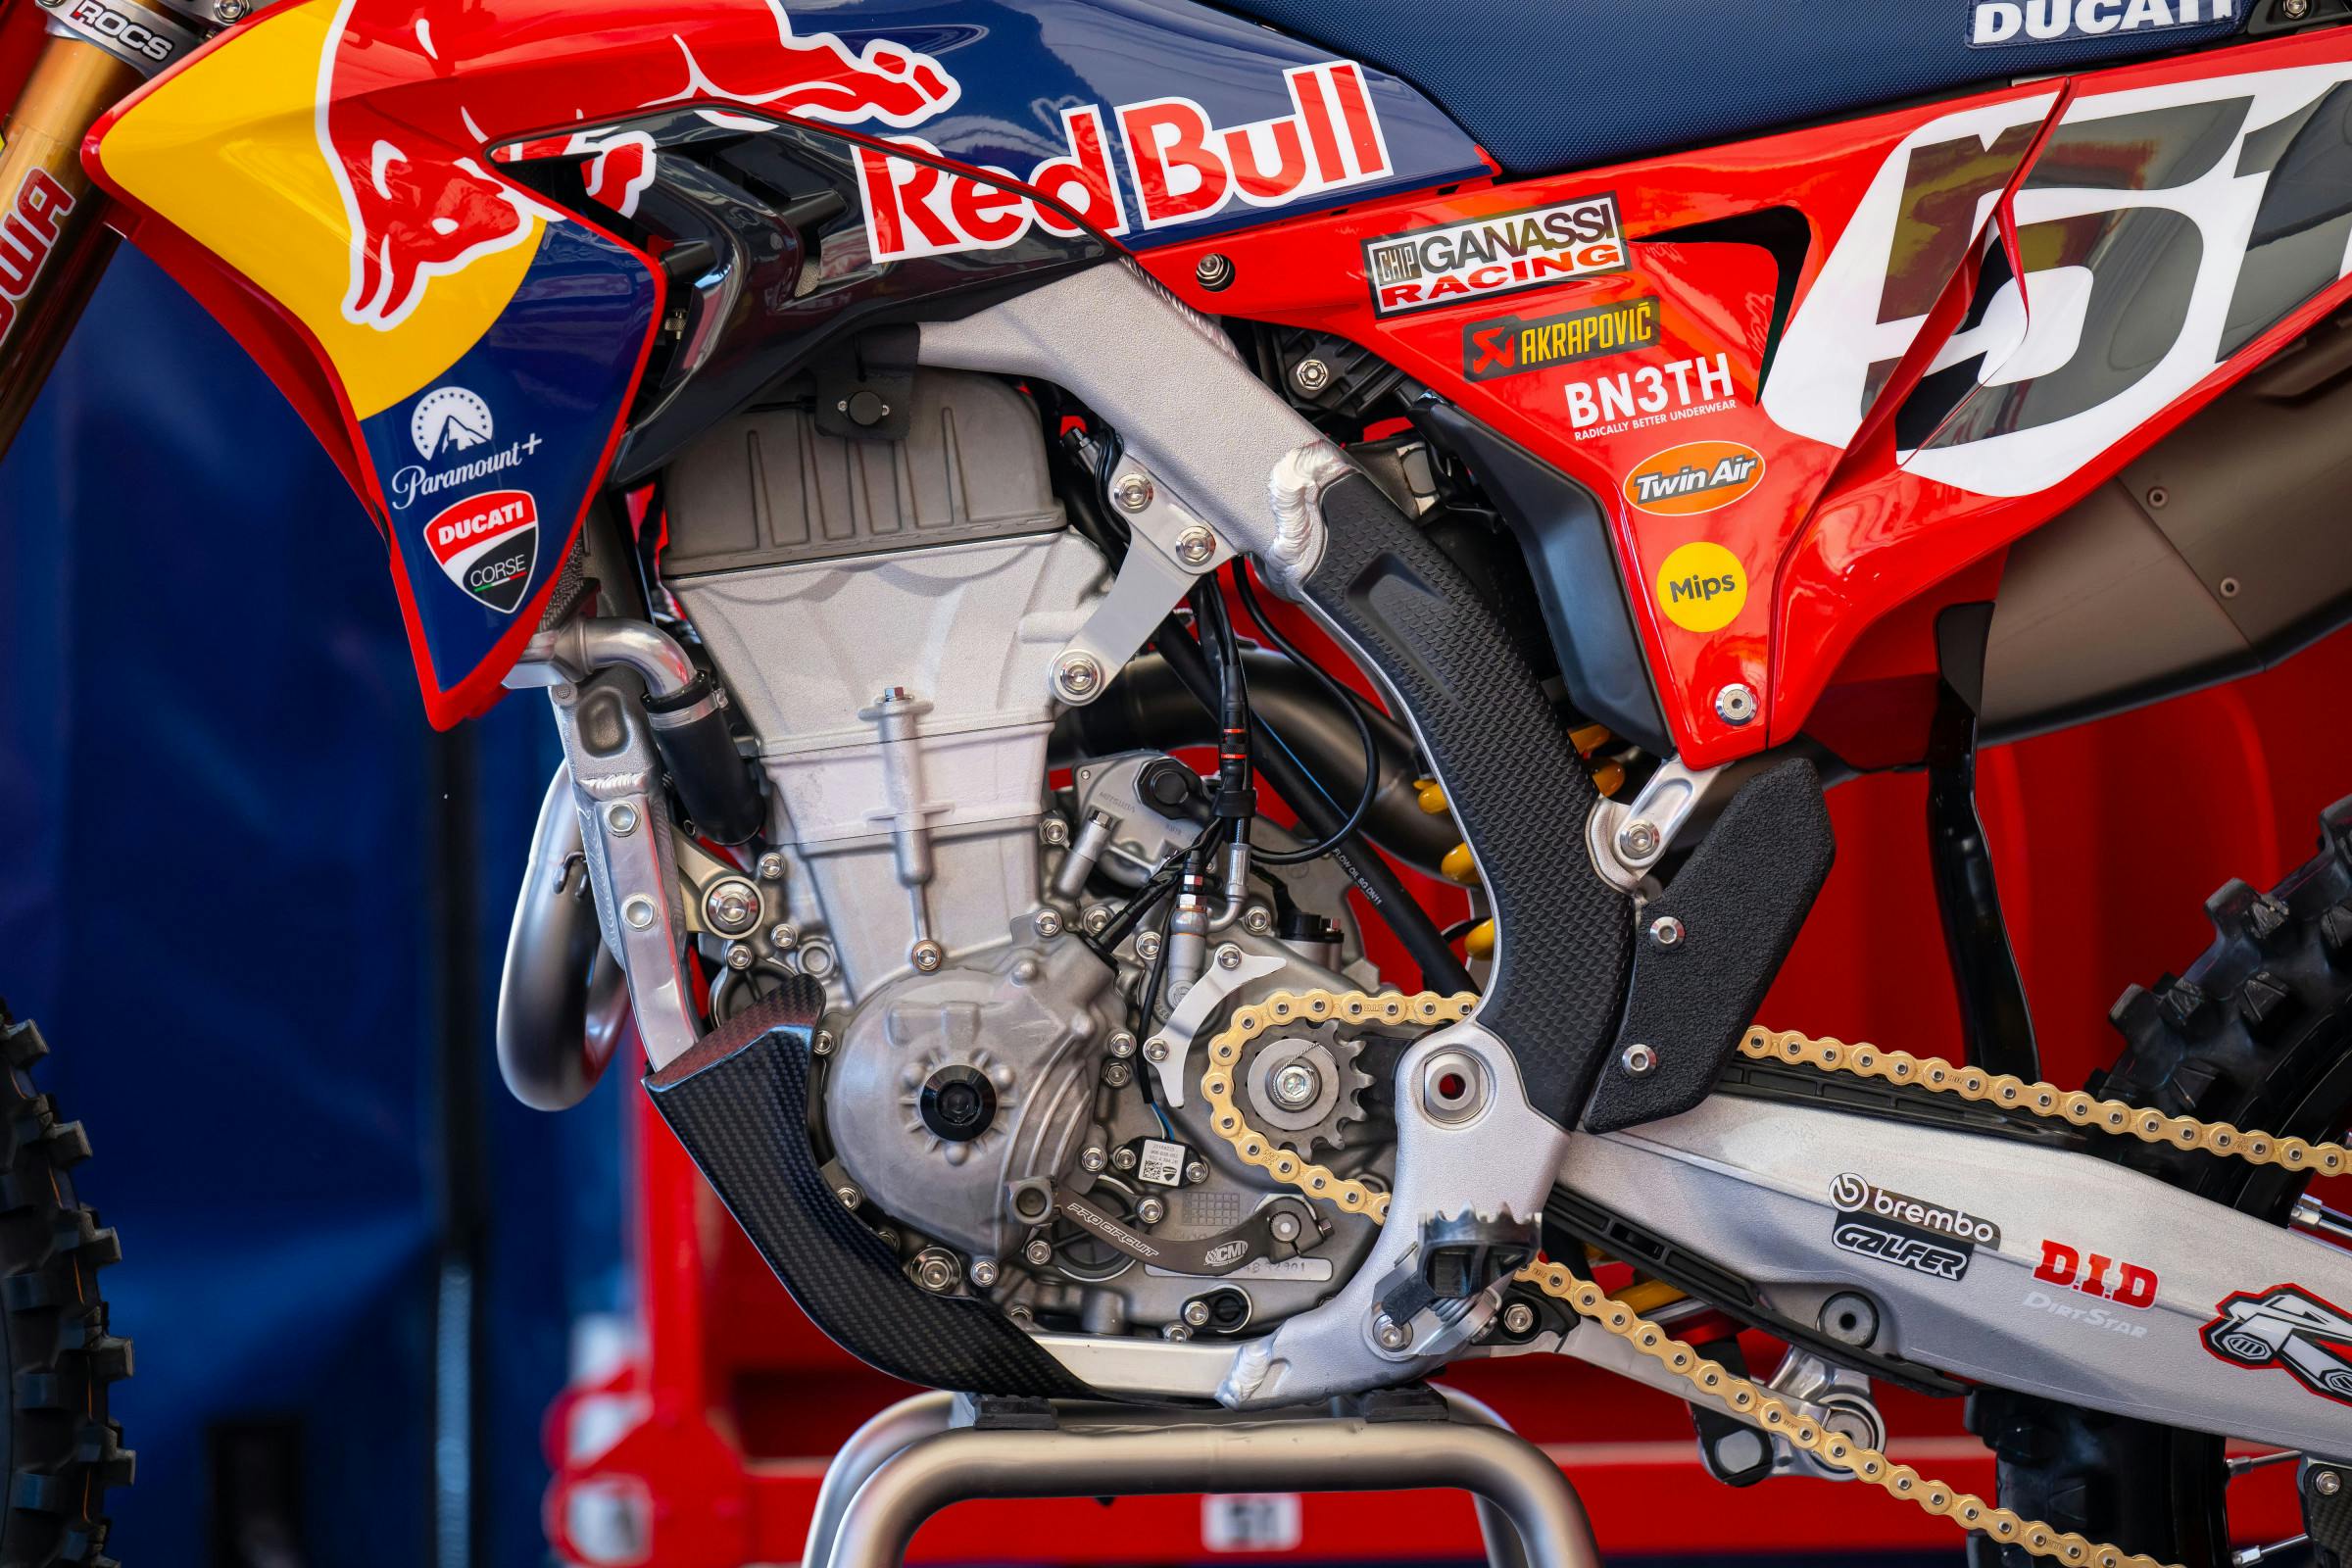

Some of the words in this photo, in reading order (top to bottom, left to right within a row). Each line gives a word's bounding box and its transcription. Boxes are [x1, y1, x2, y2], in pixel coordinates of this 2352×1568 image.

[74, 0, 172, 61] ROCS
[852, 107, 1128, 262] Red
[1116, 61, 1392, 228] Bull
[1377, 243, 1417, 283] CHIP
[1420, 204, 1615, 274] GANASSI
[1380, 244, 1620, 308] RACING
[1564, 353, 1735, 429] BN3TH
[1574, 421, 1629, 441] RADICALLY
[1633, 414, 1668, 429] BETTER
[1669, 399, 1737, 421] UNDERWEAR
[1636, 466, 1708, 501] Twin
[1708, 456, 1757, 487] Air
[438, 500, 524, 546] DUCATI
[469, 554, 526, 587] CORSE
[1669, 574, 1736, 603] Mips
[1067, 1202, 1104, 1226] PRO
[1100, 1221, 1160, 1257] CIRCUIT
[1874, 1189, 1993, 1243] brembo
[1835, 1226, 1966, 1280] GALFER
